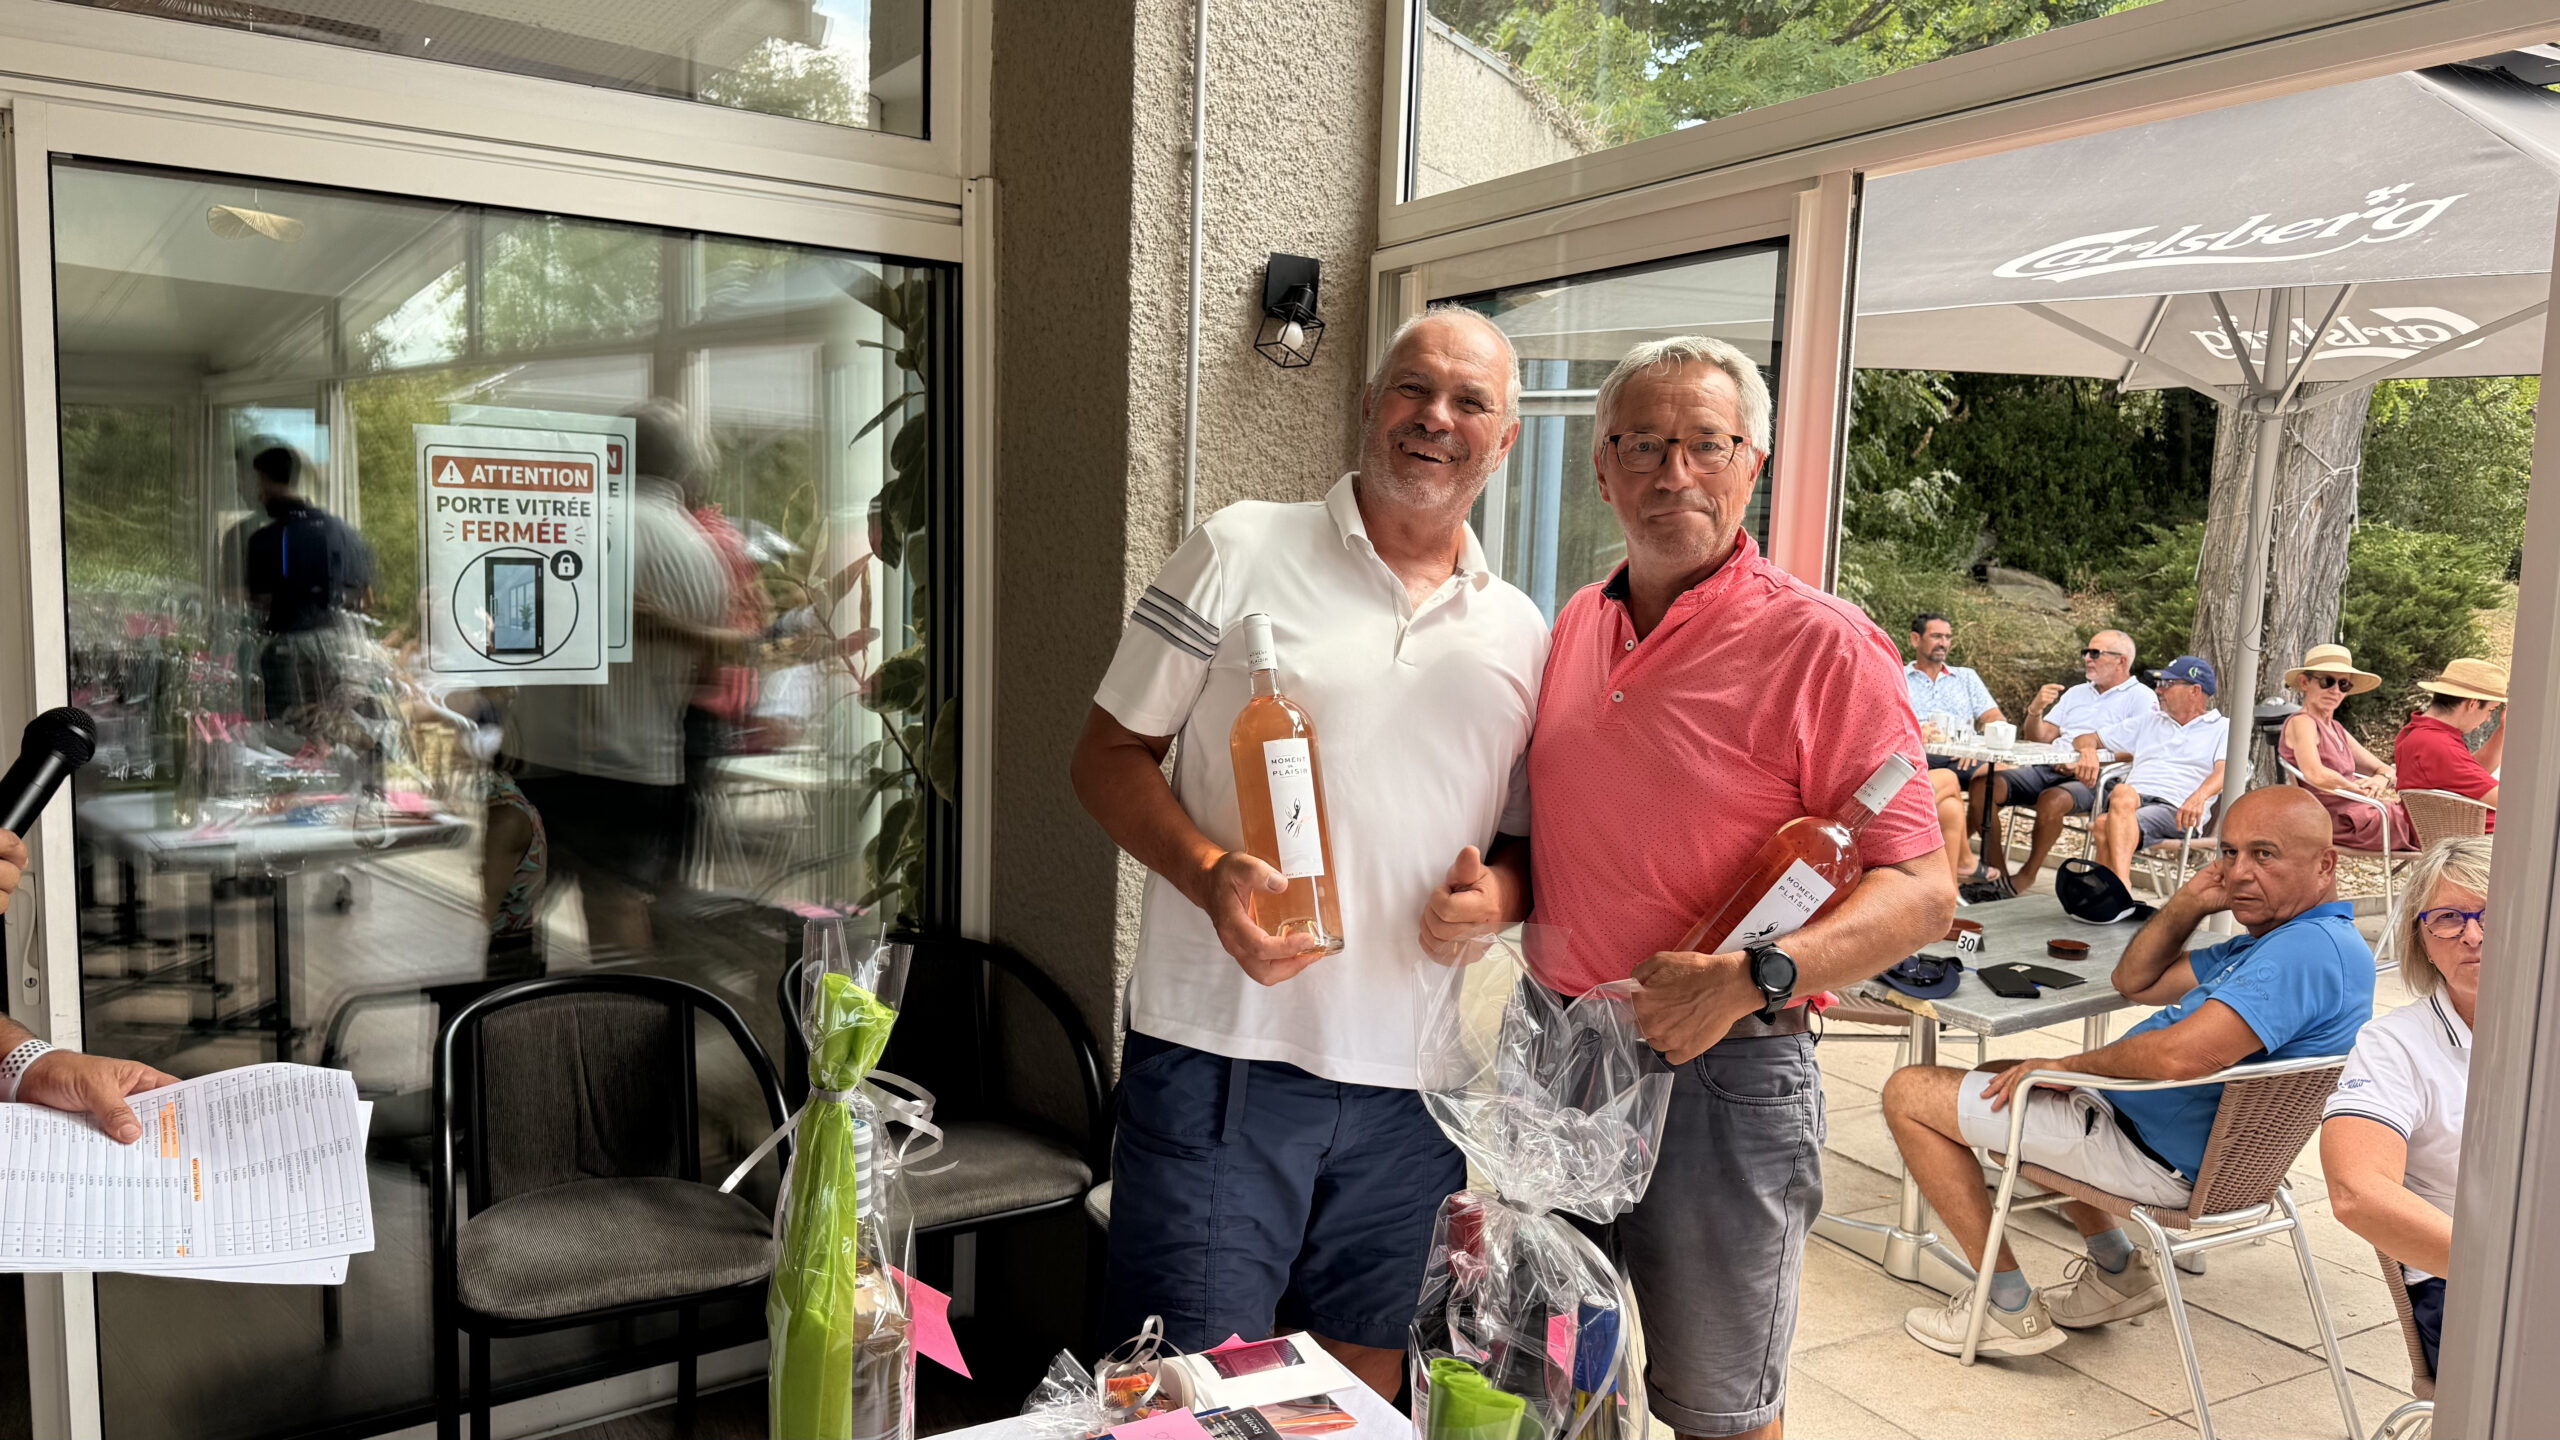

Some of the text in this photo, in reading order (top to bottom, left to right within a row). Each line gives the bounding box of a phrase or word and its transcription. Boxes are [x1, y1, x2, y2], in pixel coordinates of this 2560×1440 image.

[1993, 184, 2469, 282] Carlsberg
[470, 464, 589, 488] ATTENTION
[436, 495, 592, 518] PORTE VITRÉE
[461, 517, 568, 544] FERMÉE
[1270, 756, 1306, 765] MOMENT
[1272, 768, 1308, 776] PLAISIR
[1777, 885, 1812, 913] PLAISIR
[1786, 876, 1820, 904] MOMENT
[1957, 935, 1976, 952] 30
